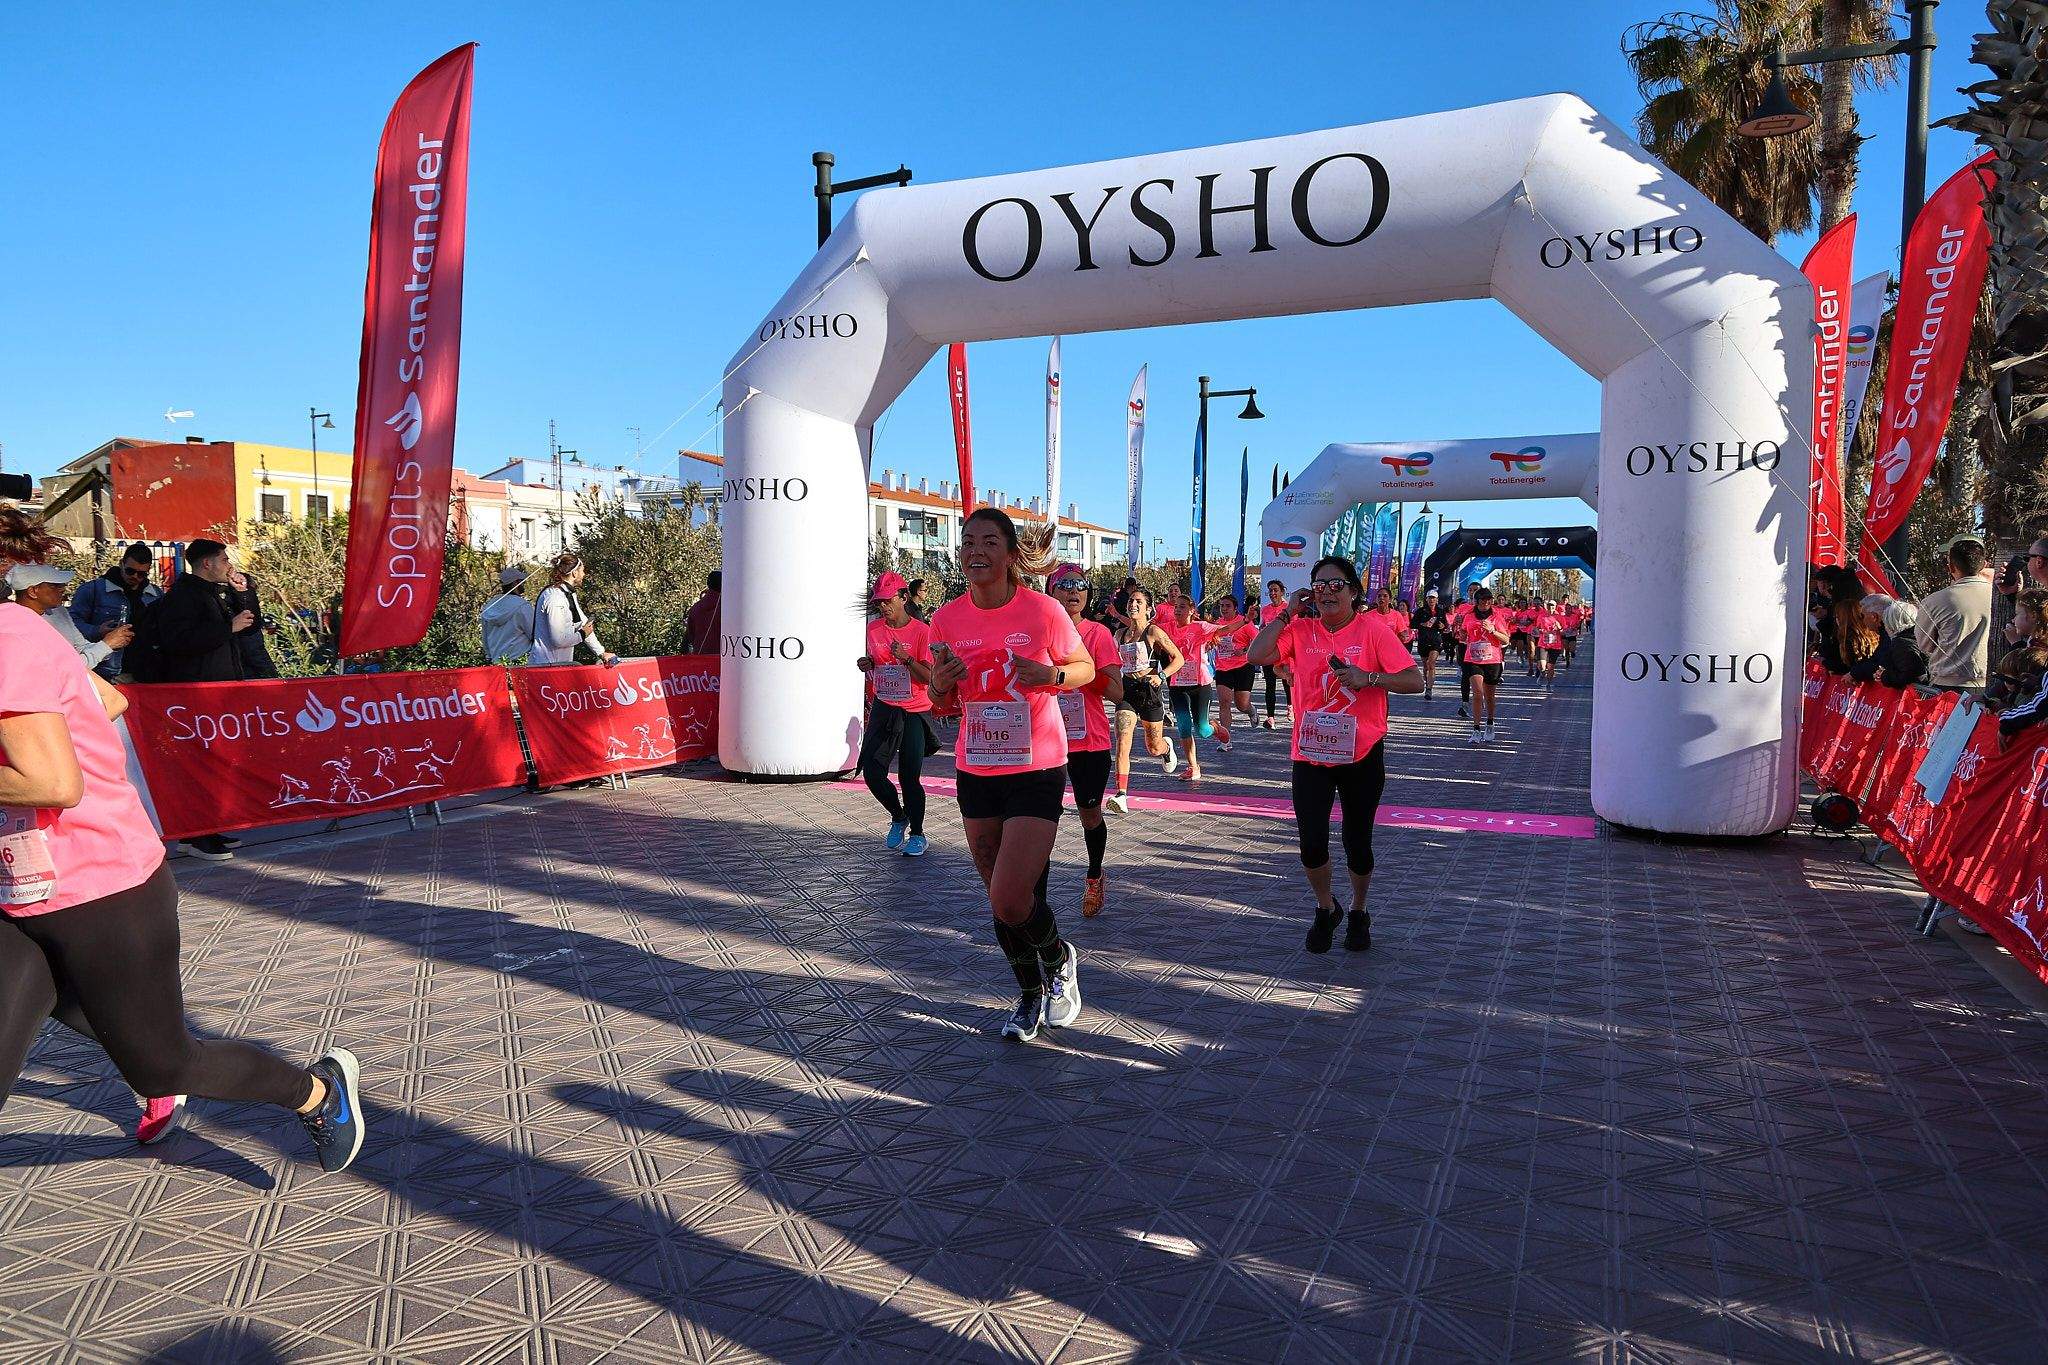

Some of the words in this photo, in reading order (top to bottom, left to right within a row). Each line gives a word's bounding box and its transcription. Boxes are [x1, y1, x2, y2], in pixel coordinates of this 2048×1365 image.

[962, 152, 1391, 283] OYSHO
[399, 132, 445, 382] Santander
[1540, 225, 1704, 269] OYSHO
[759, 313, 858, 342] OYSHO
[1893, 224, 1965, 429] Santander
[1626, 440, 1781, 476] OYSHO
[723, 477, 809, 502] OYSHO
[1490, 476, 1546, 485] TotalEnergies
[377, 460, 426, 608] Sports
[1477, 537, 1569, 546] VOLVO
[955, 639, 982, 648] OYSHO
[1620, 651, 1773, 684] OYSHO
[541, 685, 612, 719] Sports
[637, 669, 721, 702] Santande
[166, 705, 291, 748] Sports
[341, 688, 488, 729] Santander
[984, 730, 1010, 741] 016
[1316, 734, 1338, 743] 016
[1391, 812, 1559, 828] OYSHO
